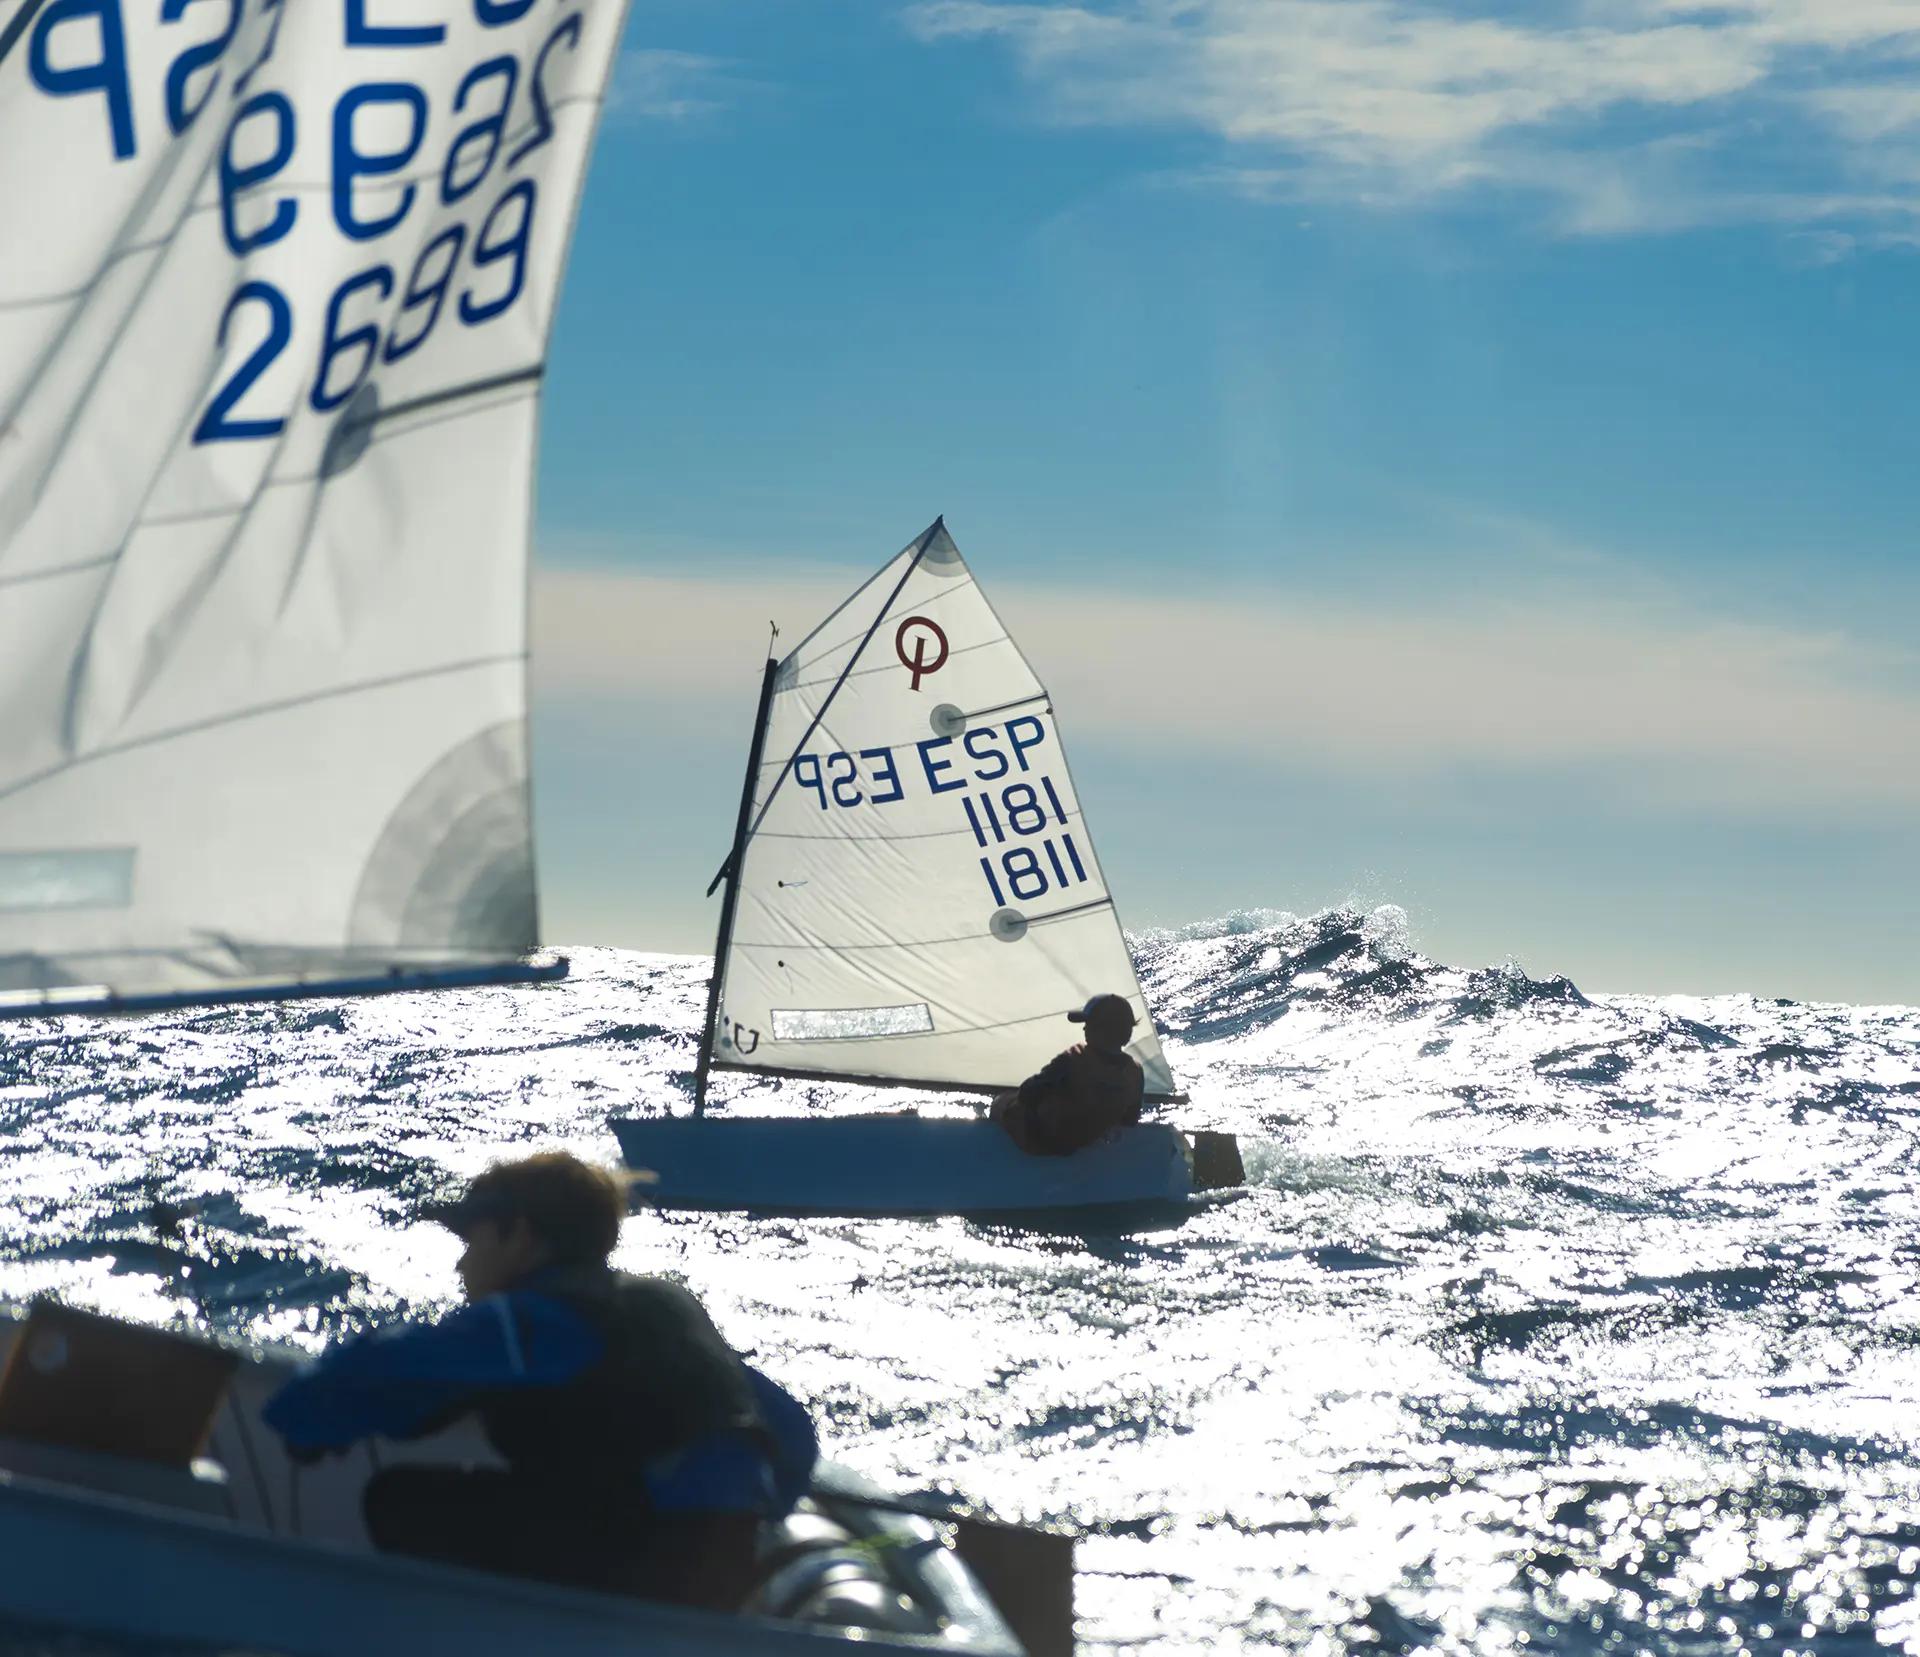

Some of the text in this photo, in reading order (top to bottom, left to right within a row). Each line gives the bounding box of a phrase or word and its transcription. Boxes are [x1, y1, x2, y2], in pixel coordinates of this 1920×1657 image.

[191, 179, 537, 446] 2699
[917, 716, 1046, 795] ESP
[980, 834, 1087, 907] 1811
